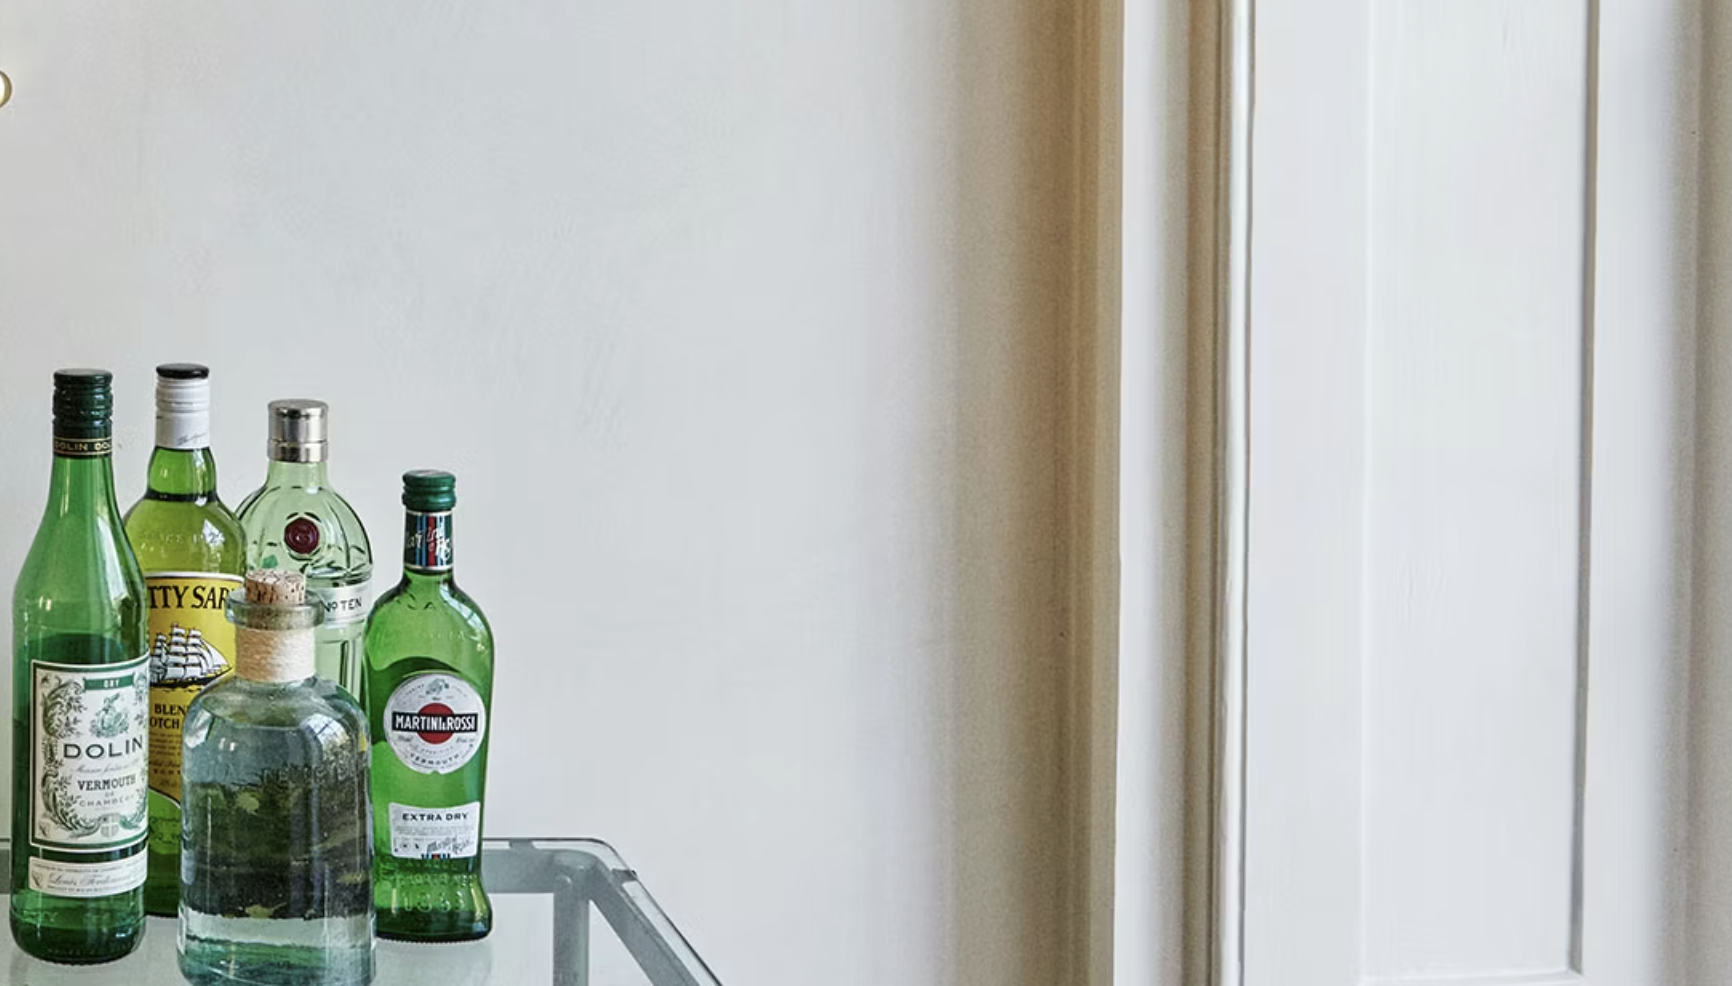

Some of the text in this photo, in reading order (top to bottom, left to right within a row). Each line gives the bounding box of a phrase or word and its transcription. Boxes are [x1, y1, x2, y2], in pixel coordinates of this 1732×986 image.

[148, 585, 232, 609] TTY SAR
[340, 597, 362, 611] TEN
[154, 703, 187, 716] BLEN
[149, 717, 180, 729] OTCH
[63, 735, 143, 759] DOLIN
[77, 774, 136, 792] VERMOUTH
[402, 812, 468, 822] EXTRA DRY
